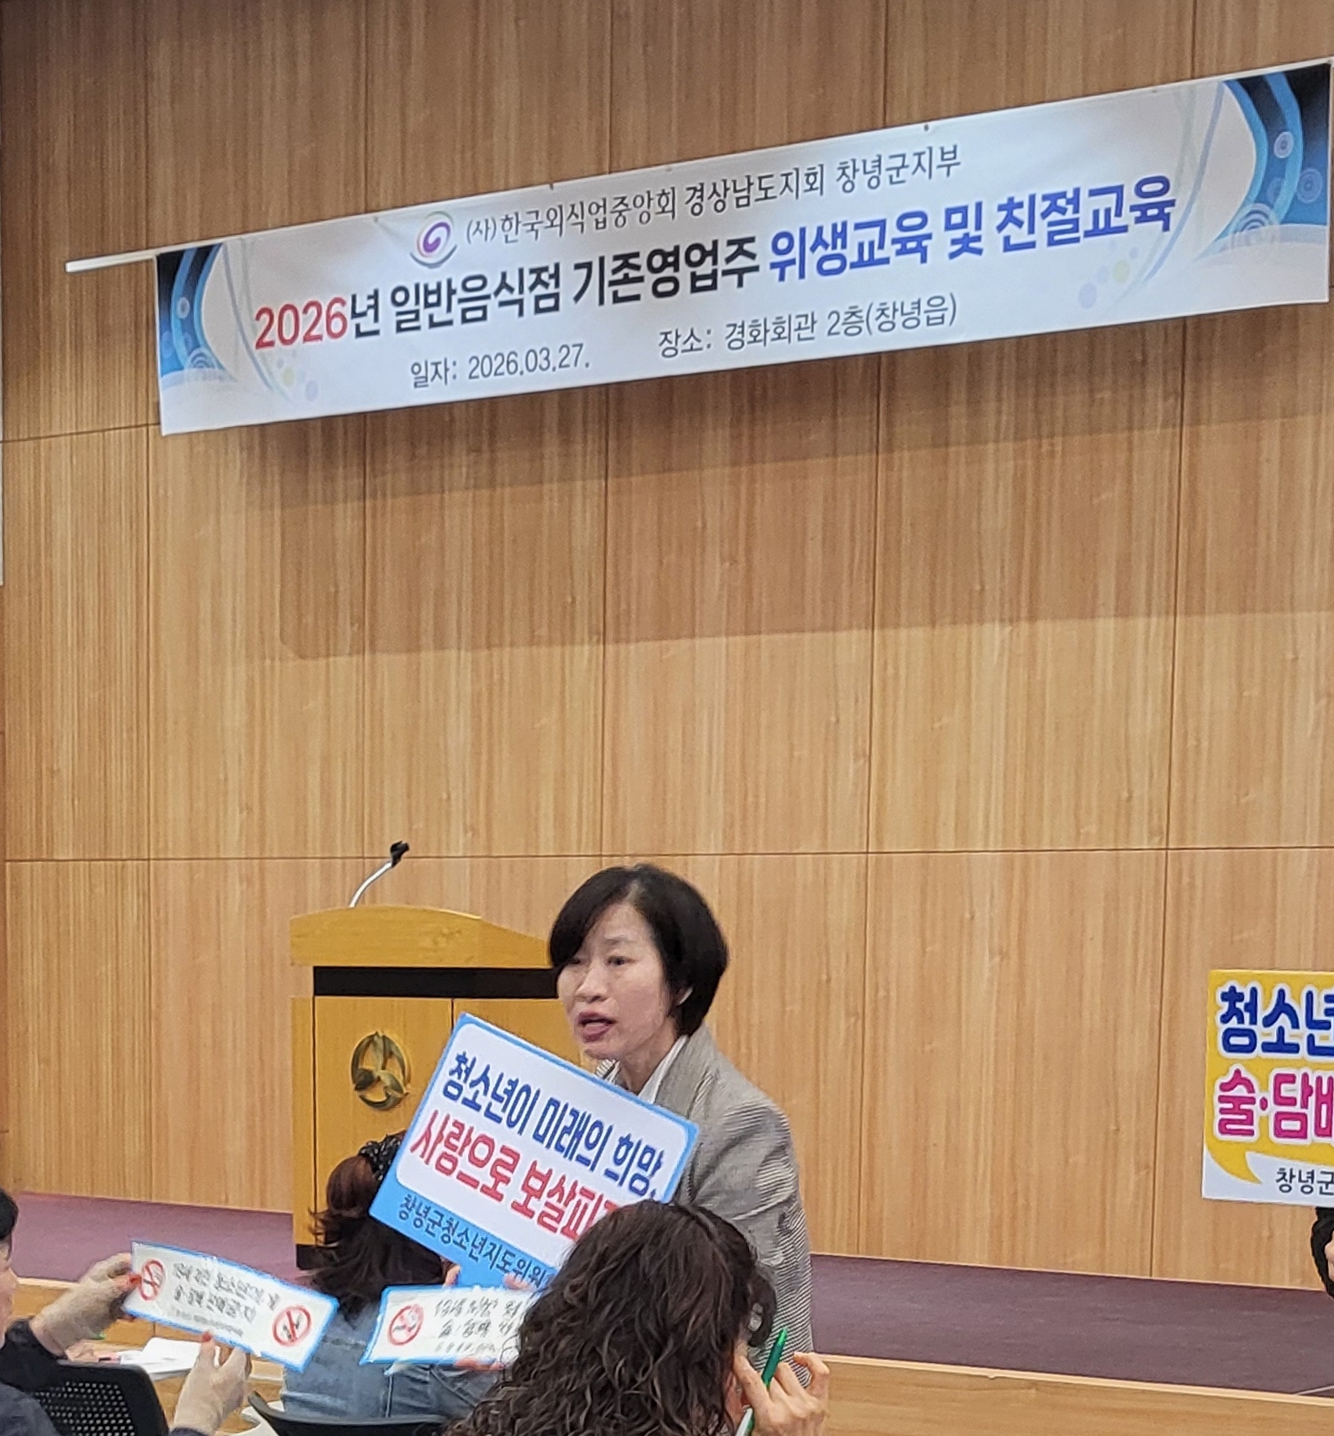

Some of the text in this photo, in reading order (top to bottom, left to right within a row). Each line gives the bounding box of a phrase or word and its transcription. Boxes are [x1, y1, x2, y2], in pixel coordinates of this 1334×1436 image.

[685, 163, 826, 218] 경상남도지회
[836, 144, 963, 194] 창녕군지부
[254, 174, 1176, 350] 2026년 일반음식점 기존영업주 위생교육 및 친절교육
[410, 292, 958, 388] 일자: 2026.03.27. 장소: 경화회관 2층(창녕읍)
[409, 1109, 622, 1243] 사랑으로 보살피
[442, 1050, 665, 1201] 청소년이 미래의 희망,
